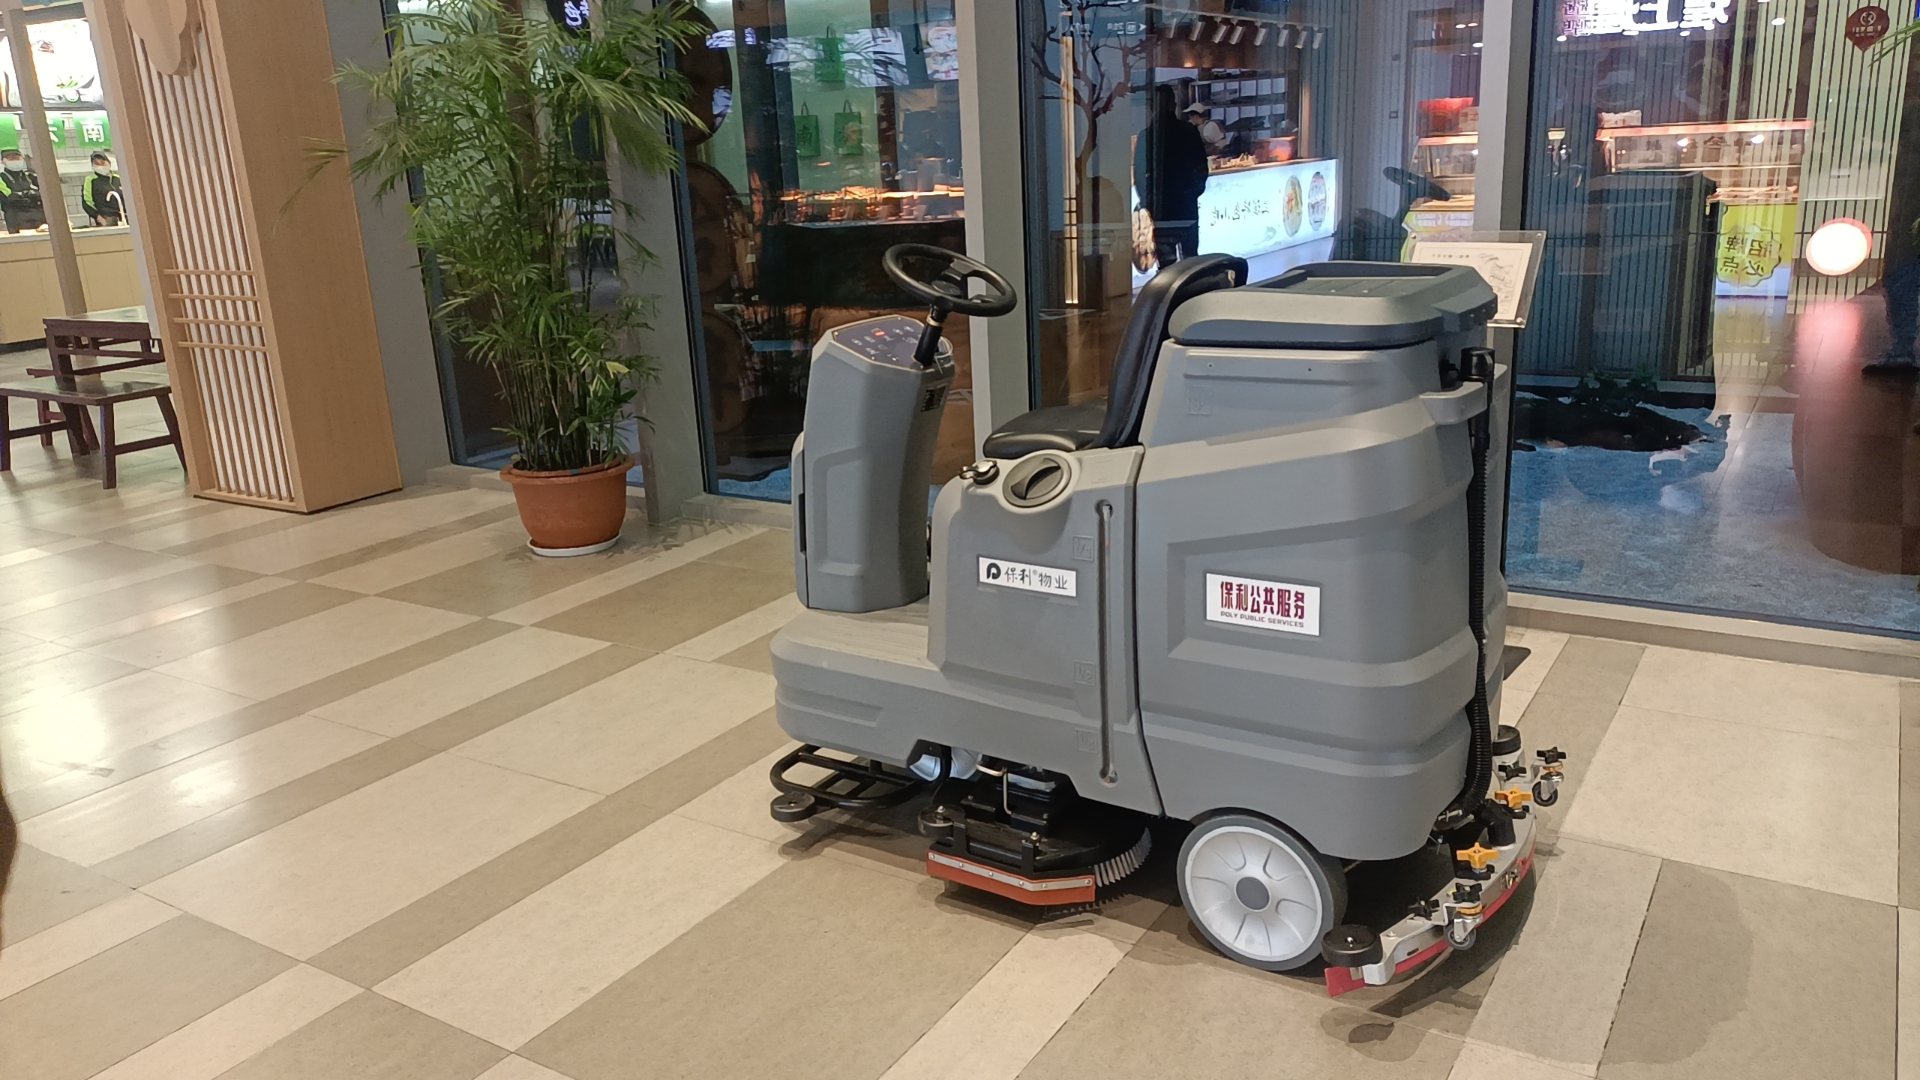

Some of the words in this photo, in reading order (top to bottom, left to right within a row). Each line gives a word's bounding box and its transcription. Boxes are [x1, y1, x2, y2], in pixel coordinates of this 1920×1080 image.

[1220, 581, 1305, 620] 保利公共服务
[1220, 610, 1238, 619] POLY
[1240, 613, 1265, 623] PUBLIC
[1268, 617, 1304, 628] SERVICES
